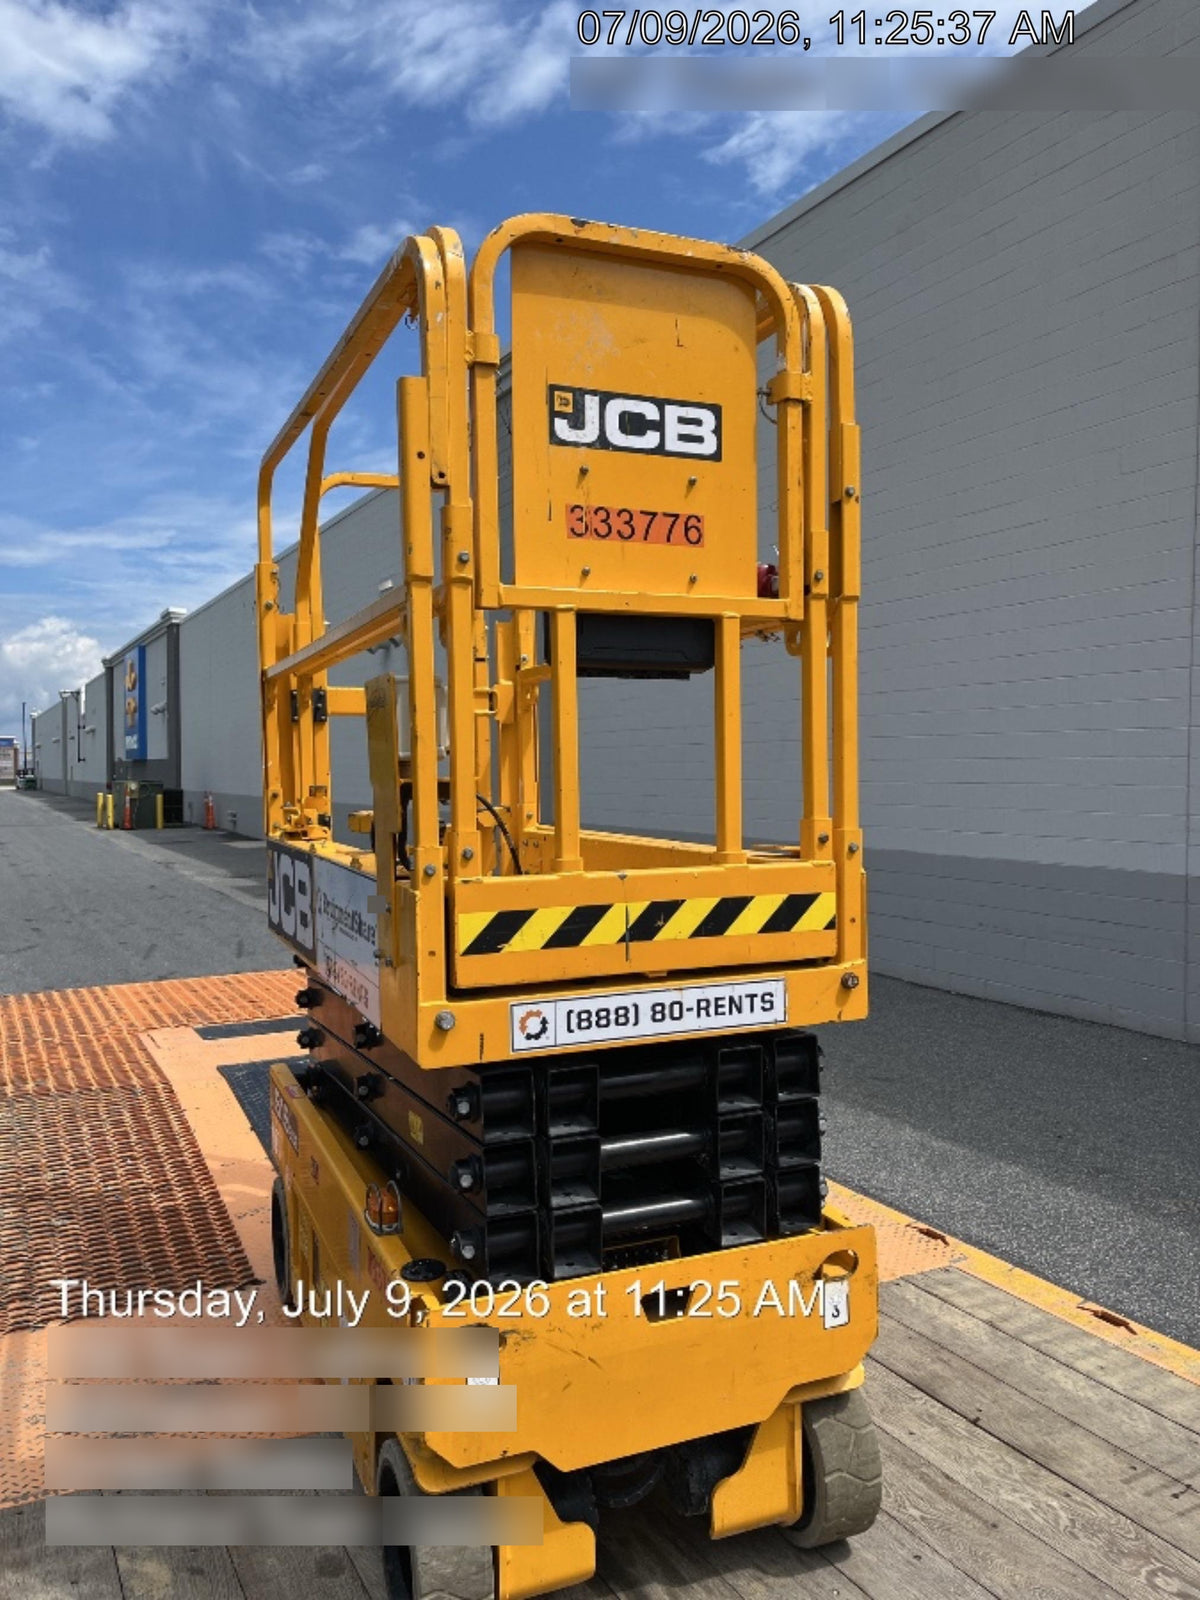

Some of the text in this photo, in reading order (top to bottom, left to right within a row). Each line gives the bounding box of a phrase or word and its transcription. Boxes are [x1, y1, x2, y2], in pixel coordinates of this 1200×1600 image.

[554, 394, 717, 455] JCB
[570, 504, 702, 545] 333776
[269, 850, 313, 950] JCB
[566, 992, 775, 1033] (888) 80-RENTS
